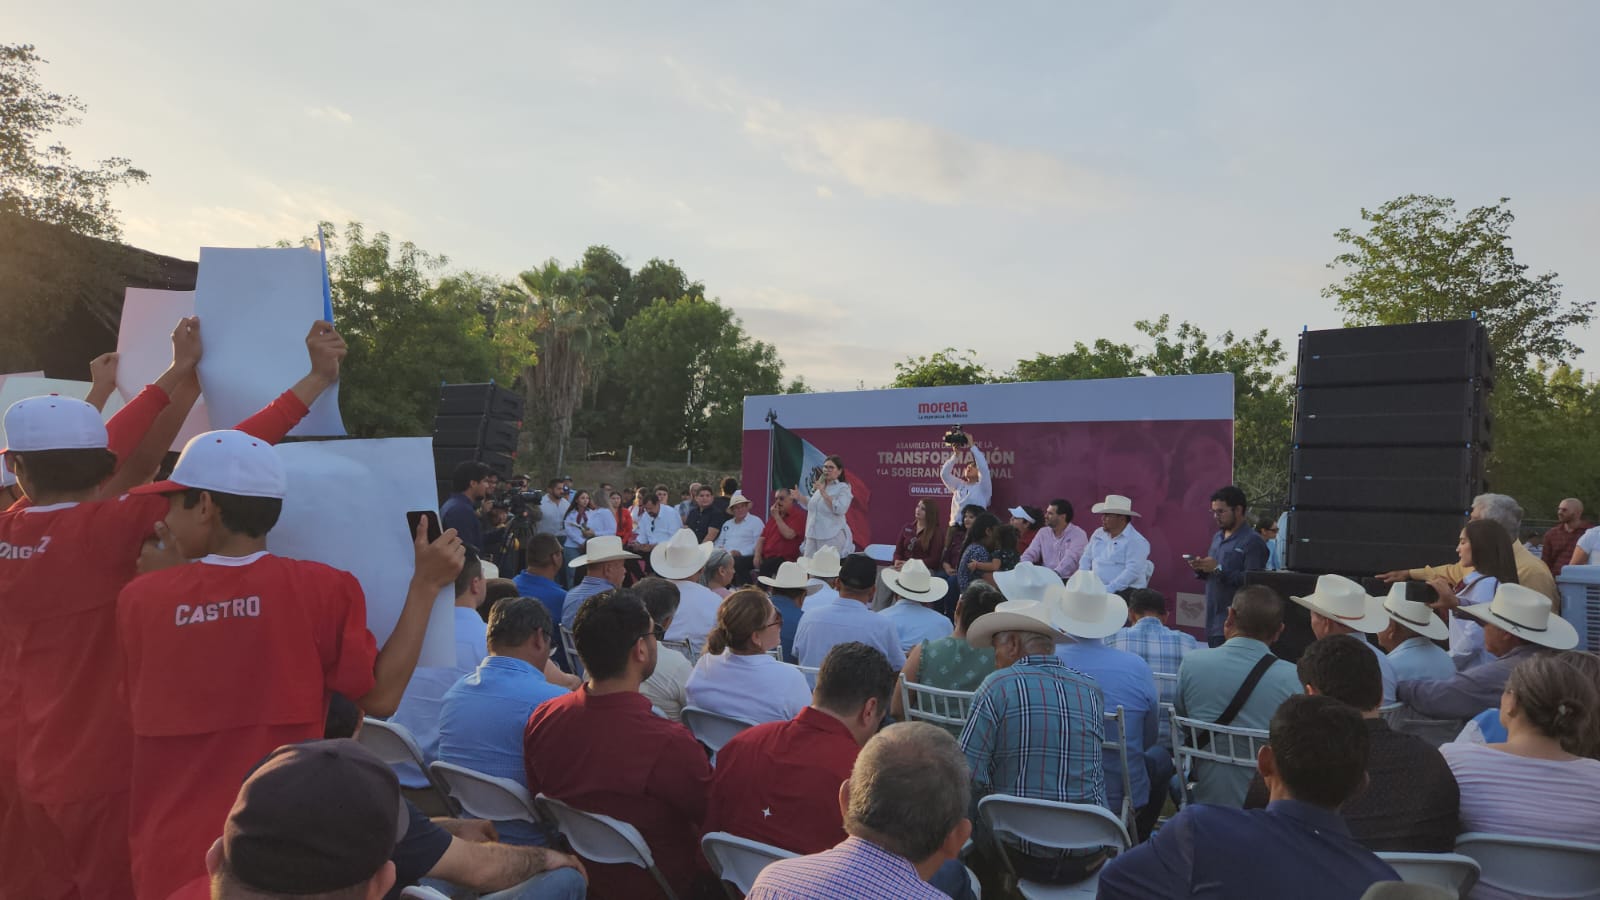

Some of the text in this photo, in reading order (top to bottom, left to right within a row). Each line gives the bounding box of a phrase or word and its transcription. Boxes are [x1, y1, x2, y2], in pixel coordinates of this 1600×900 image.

[918, 401, 968, 414] morena
[895, 441, 930, 449] ASAMBLEA
[878, 447, 1015, 465] TRANSFORMAIÓN
[881, 468, 889, 476] LA
[891, 466, 943, 478] SOBERAN
[175, 595, 261, 626] CASTRO
